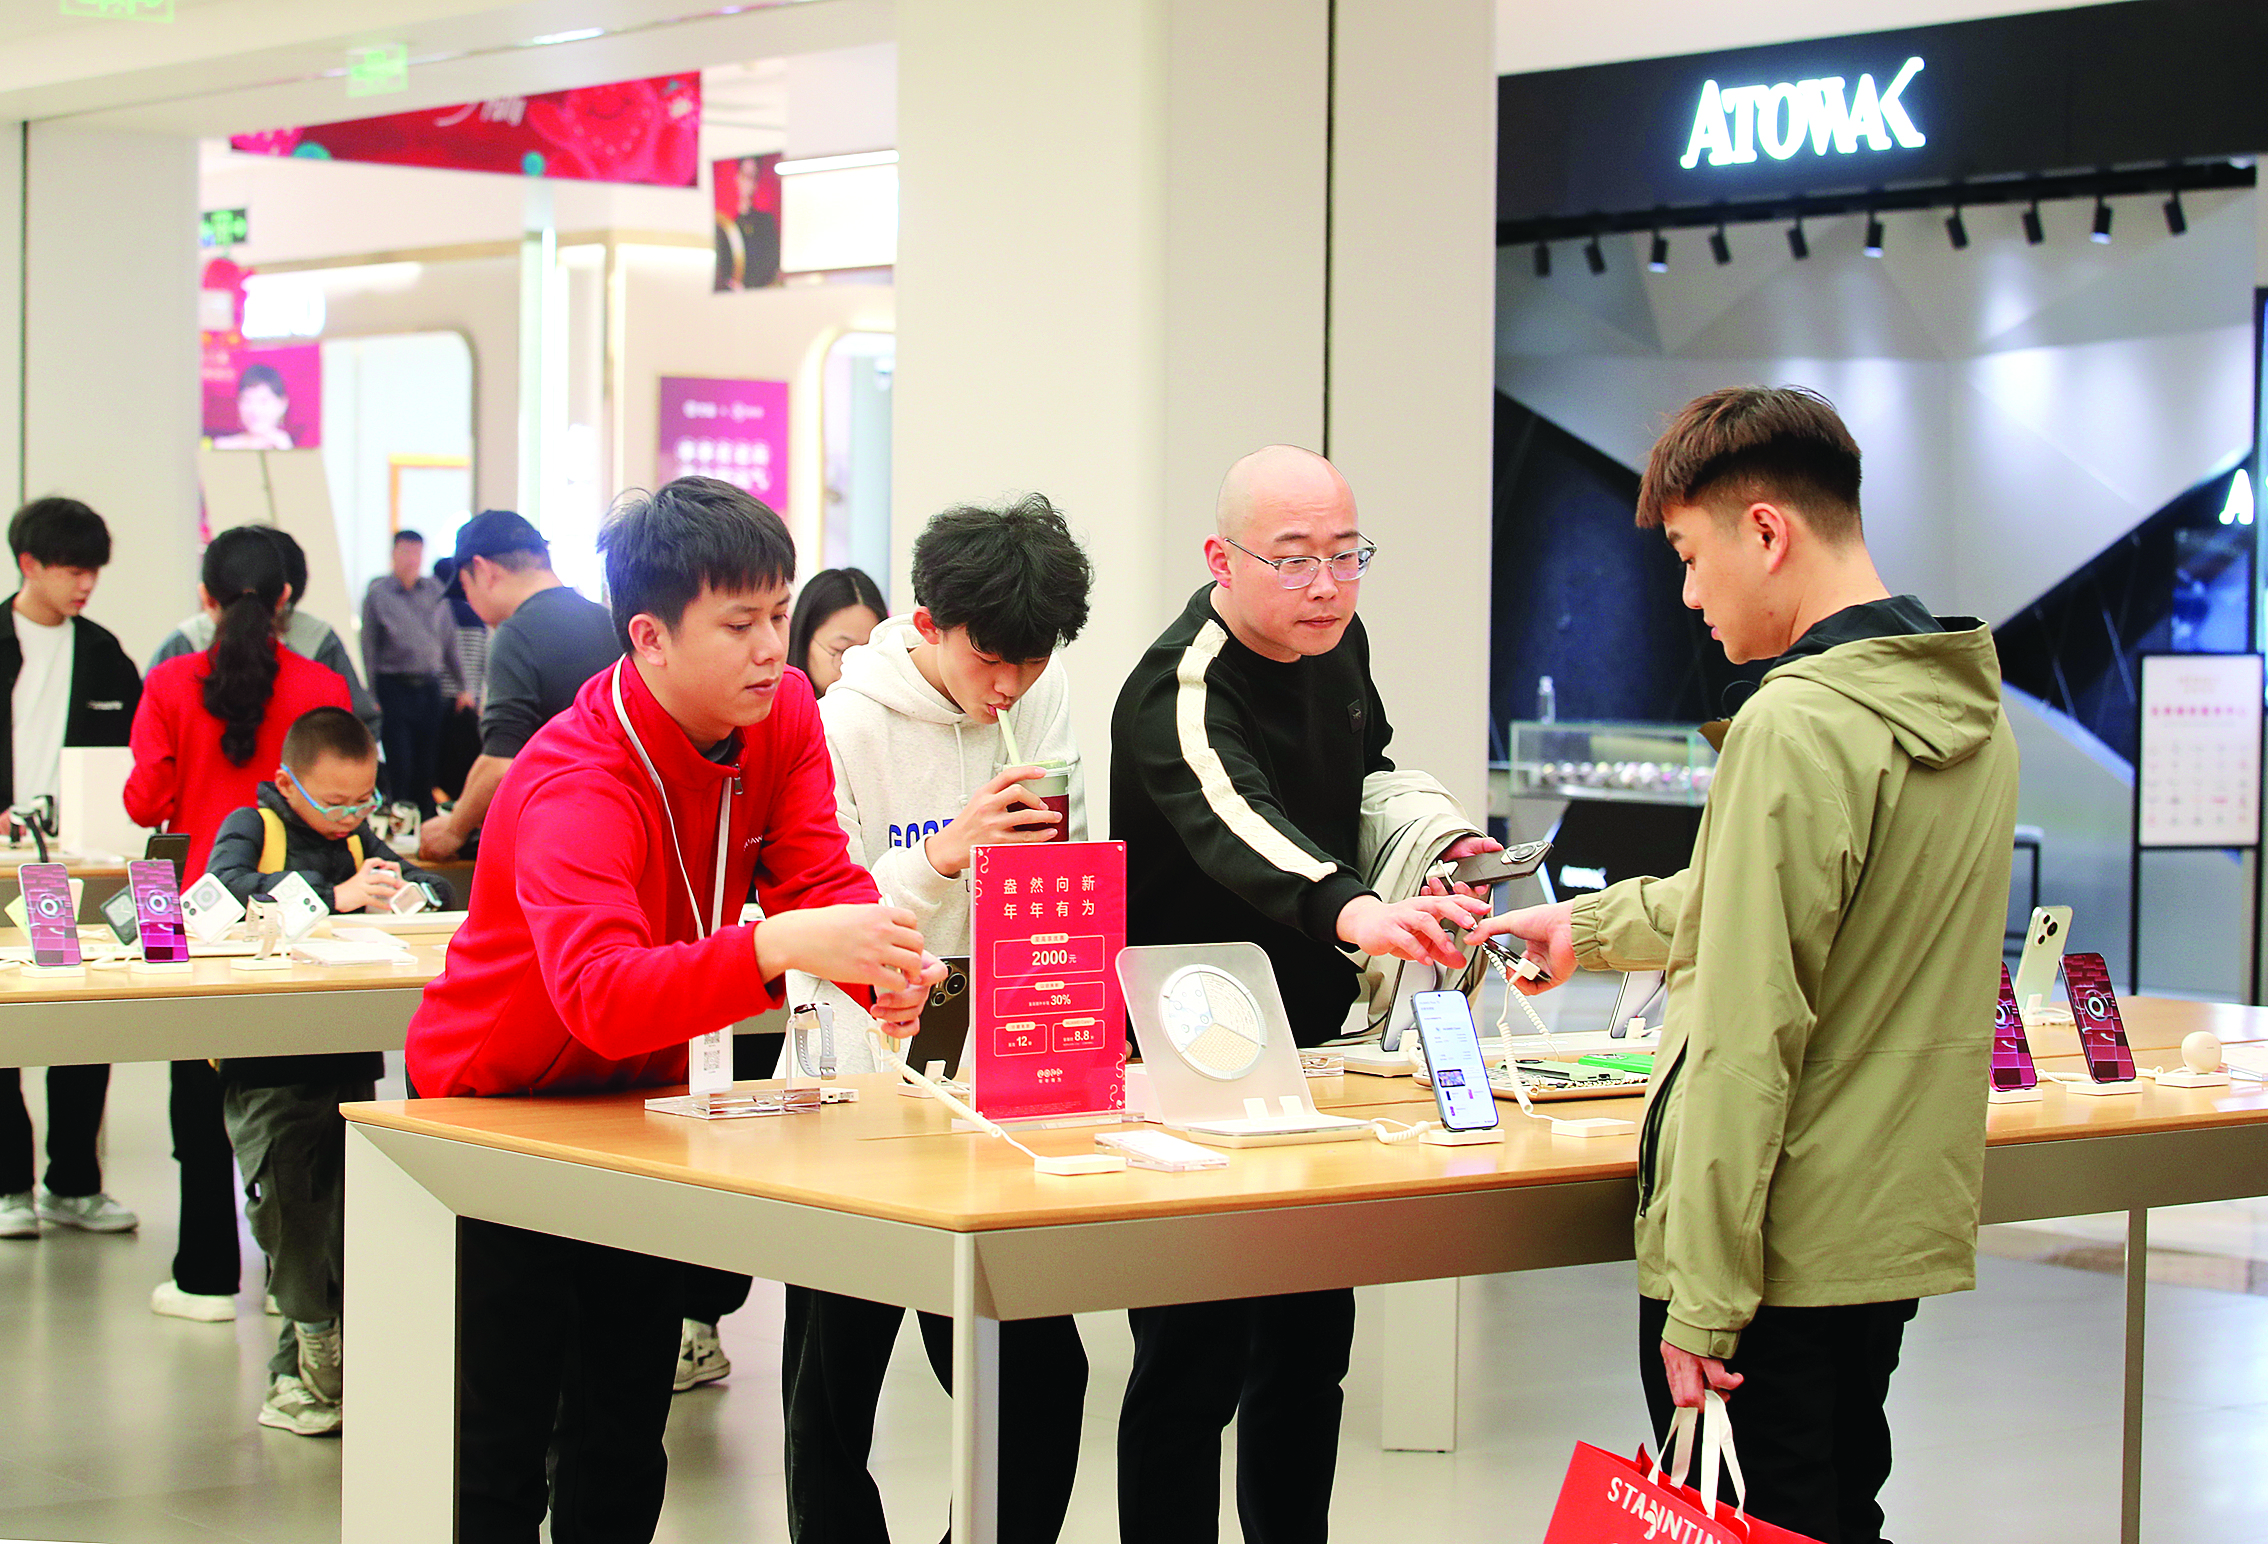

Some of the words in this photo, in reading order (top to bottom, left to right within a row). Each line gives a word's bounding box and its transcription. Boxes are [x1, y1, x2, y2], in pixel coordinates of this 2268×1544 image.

[1680, 56, 1926, 169] ATOWAK
[889, 818, 954, 848] GOO
[1003, 874, 1096, 895] 盎然向新
[1003, 899, 1095, 920] 年年有为
